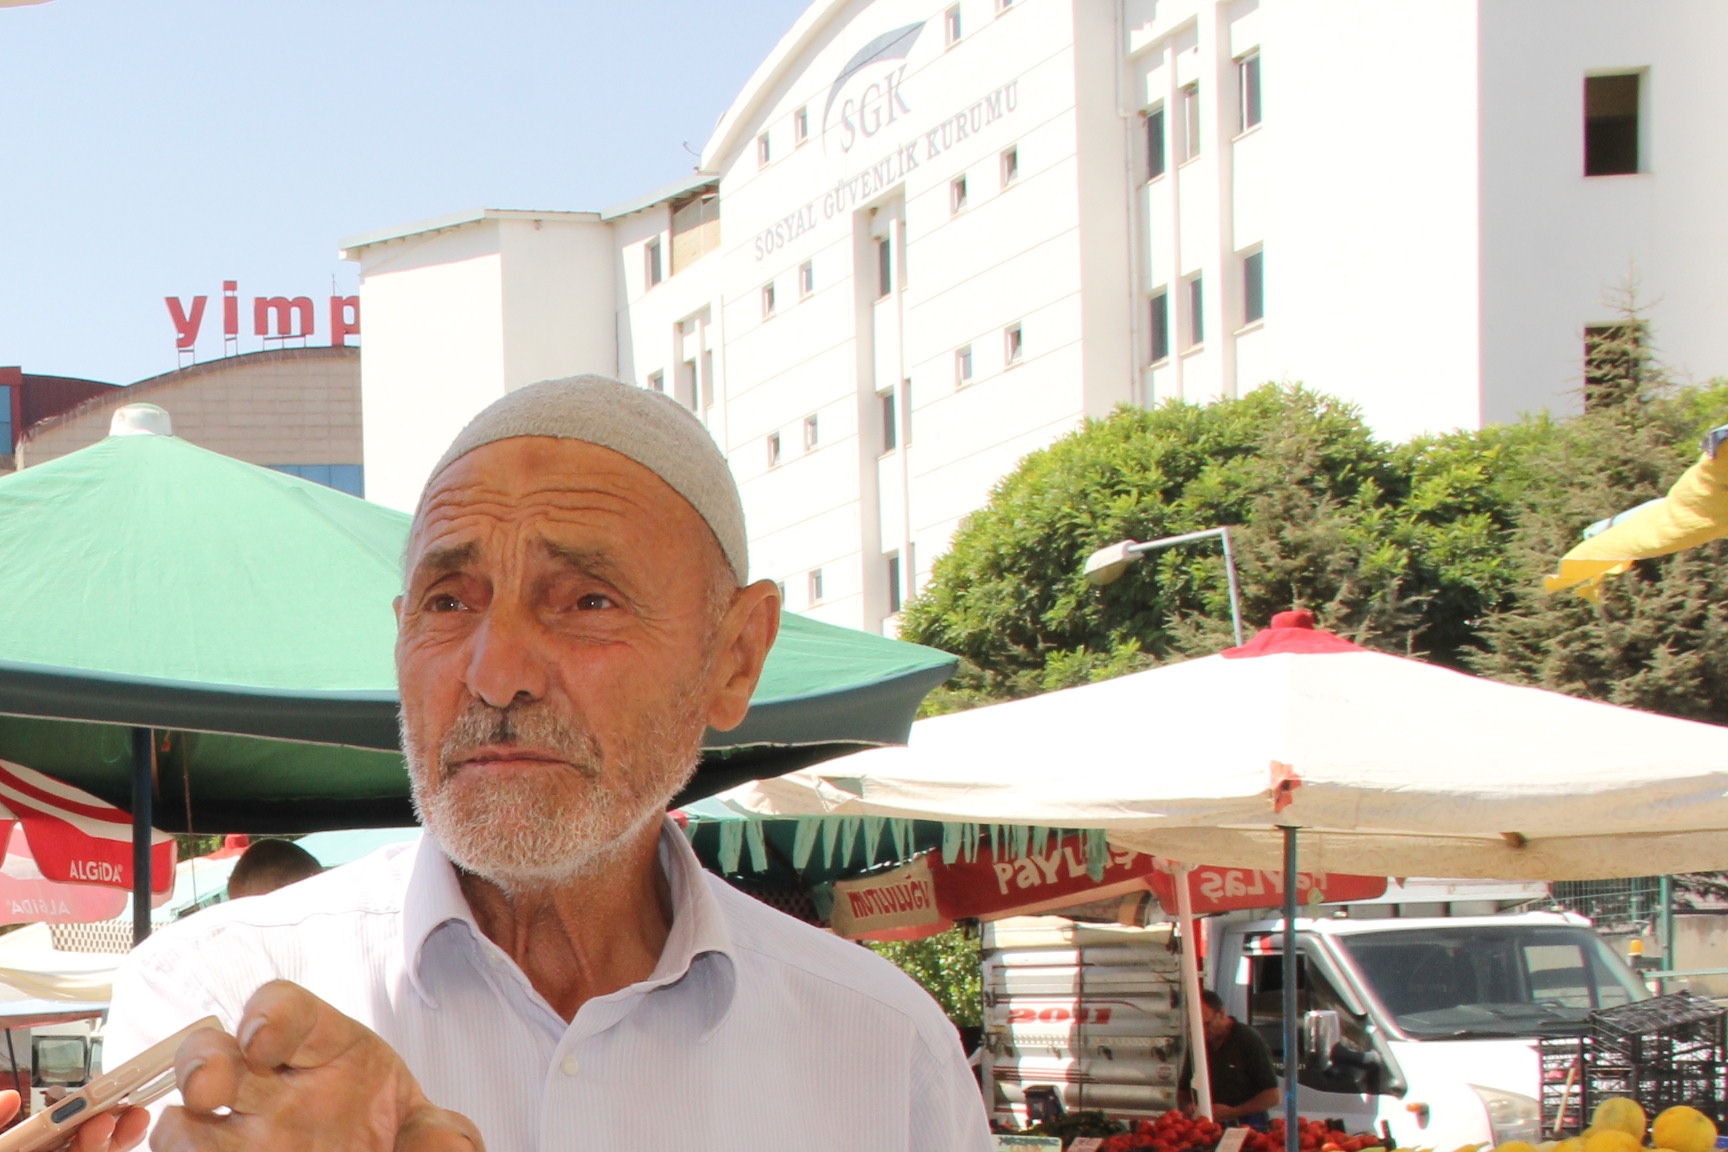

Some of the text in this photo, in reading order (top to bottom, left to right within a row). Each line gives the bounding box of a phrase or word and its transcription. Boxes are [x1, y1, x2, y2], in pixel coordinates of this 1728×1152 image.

[840, 62, 912, 154] SGK
[755, 78, 1018, 262] SOSYAL GÜVENLİK KURUMU
[164, 280, 361, 348] yimp
[1007, 1007, 1112, 1025] 2011
